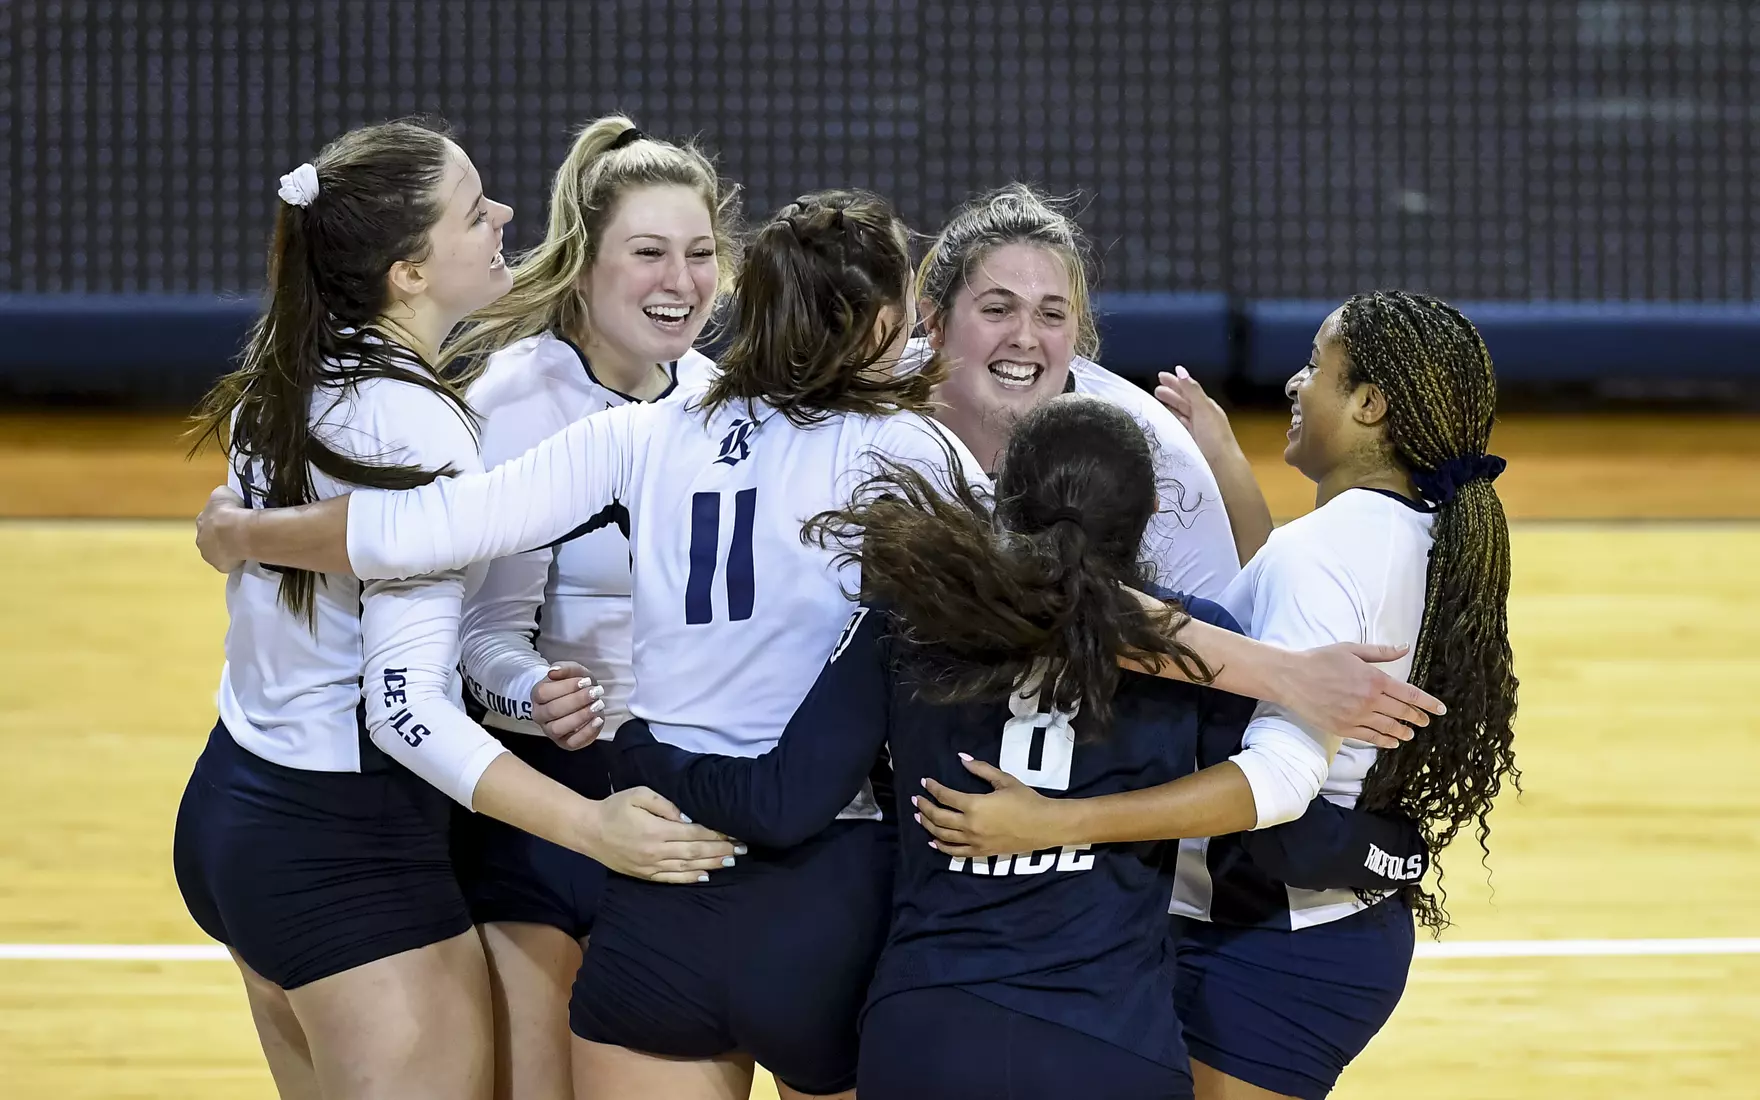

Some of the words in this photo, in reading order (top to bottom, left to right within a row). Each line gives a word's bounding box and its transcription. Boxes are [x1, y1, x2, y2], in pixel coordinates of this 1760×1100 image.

[713, 418, 760, 466] R
[685, 487, 757, 625] 11
[1000, 656, 1082, 791] 8
